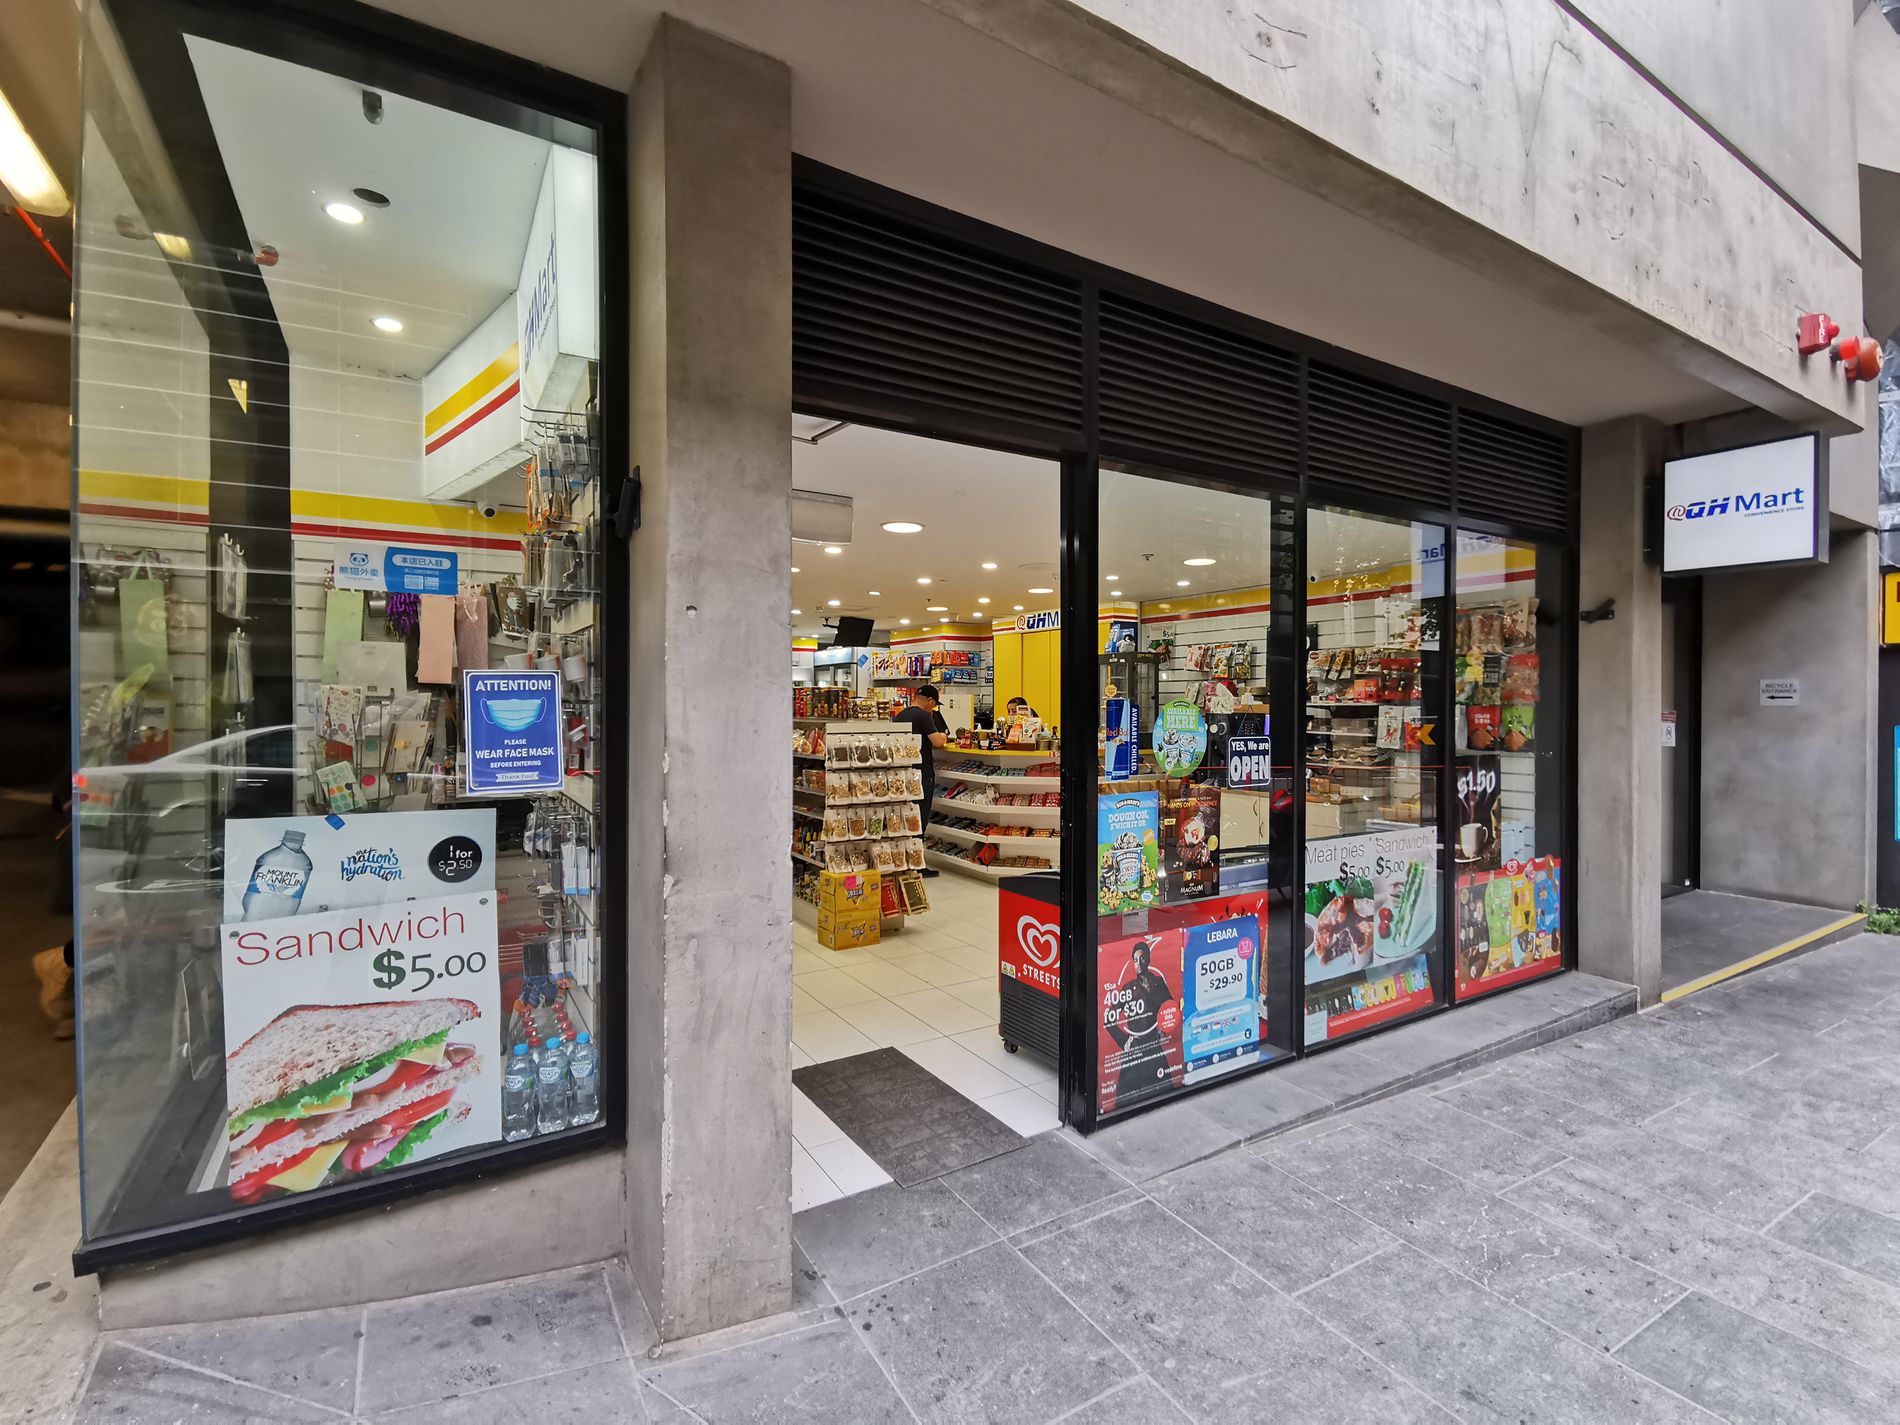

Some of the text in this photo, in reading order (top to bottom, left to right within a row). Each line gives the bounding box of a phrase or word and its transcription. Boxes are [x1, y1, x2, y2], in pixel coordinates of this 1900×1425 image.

[1735, 488, 1804, 512] Mart
[1744, 509, 1784, 518] CONVENIENCE
[475, 679, 552, 692] ATTENTION!
[1166, 715, 1196, 729] HERE
[1106, 728, 1118, 737] Red
[475, 746, 555, 759] WEAR FACE MASK
[1231, 741, 1269, 752] YES, We are
[513, 760, 542, 768] ENTERING
[1231, 755, 1269, 781] OPEN
[1457, 769, 1496, 799] $1.50
[1108, 811, 1136, 823] DOUGH
[1305, 842, 1365, 864] Meat pies
[1376, 835, 1429, 855] Sandwich
[346, 847, 399, 866] nation's
[455, 849, 473, 859] for
[267, 869, 298, 878] MOUNT
[341, 860, 405, 882] hydration
[438, 859, 473, 876] $2.50
[1339, 861, 1370, 884] $5.00
[1376, 856, 1405, 878] $5.00
[256, 871, 304, 887] FRANKLIN
[235, 907, 464, 966] Sandwich
[1207, 927, 1238, 943] LEBARA
[372, 949, 487, 993] $5.00
[1209, 972, 1243, 990] $29.90
[1104, 1007, 1121, 1024] for
[1124, 999, 1145, 1018] $30
